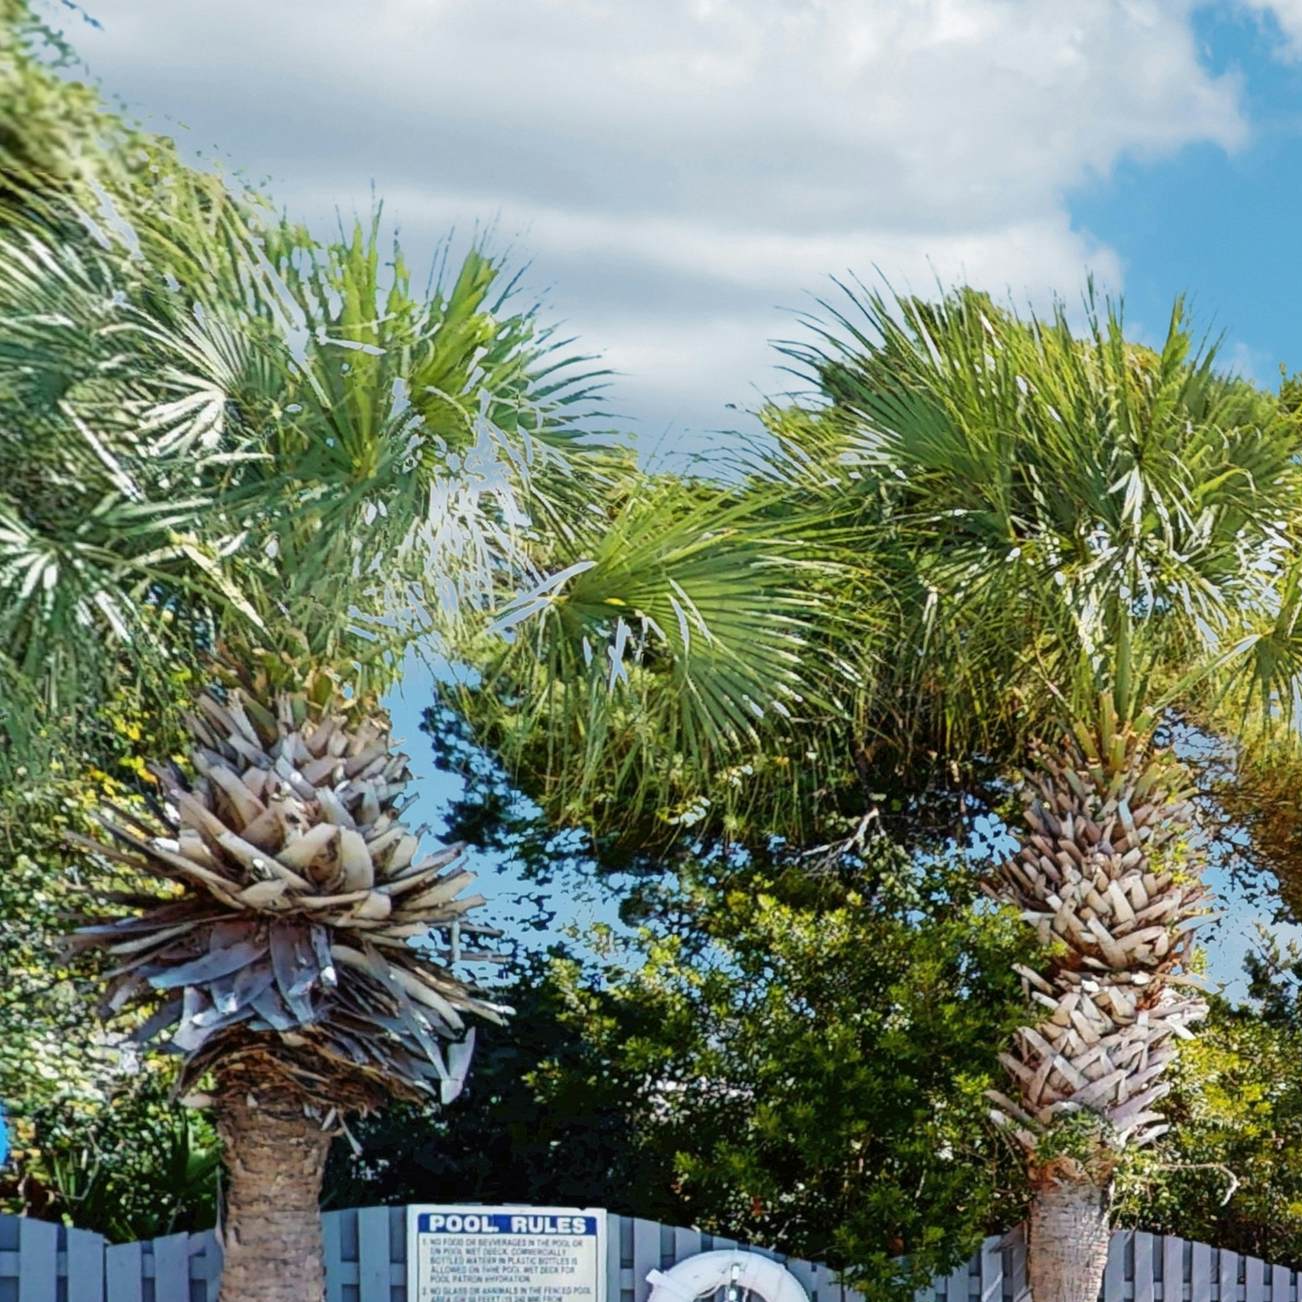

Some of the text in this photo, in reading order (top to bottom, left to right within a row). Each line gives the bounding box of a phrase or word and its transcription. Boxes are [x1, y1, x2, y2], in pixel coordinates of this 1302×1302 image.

[429, 1215, 586, 1234] POOL RULES
[431, 1239, 442, 1247] NO
[443, 1239, 464, 1247] FOOD
[466, 1239, 476, 1247] OR
[552, 1240, 571, 1248] POOL
[508, 1257, 536, 1265] PLASTIC
